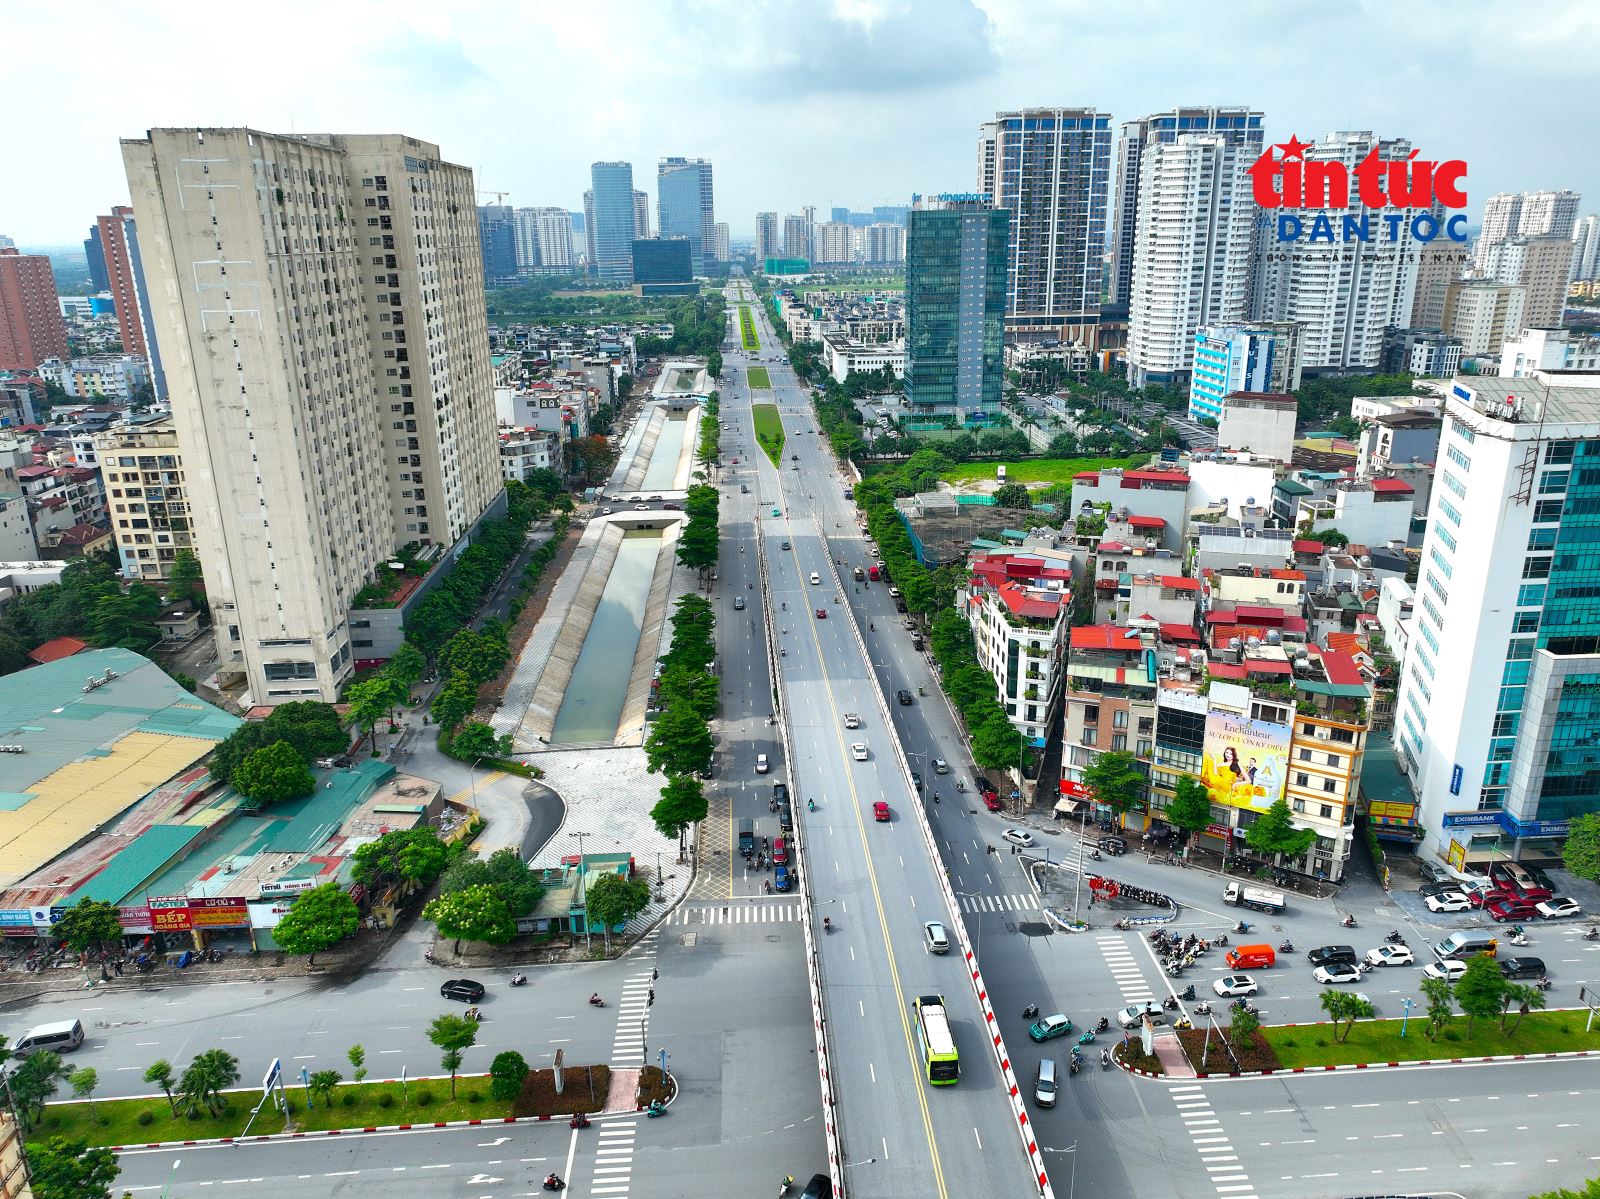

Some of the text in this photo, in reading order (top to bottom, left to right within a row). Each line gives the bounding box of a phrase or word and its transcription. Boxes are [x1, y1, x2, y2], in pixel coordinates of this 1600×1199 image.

[1224, 722, 1272, 739] Enchanteur
[1454, 815, 1495, 823] EXIMBANK
[1541, 825, 1569, 833] EXIMBA
[155, 910, 187, 923] BẾP
[154, 922, 178, 930] HOÀNG
